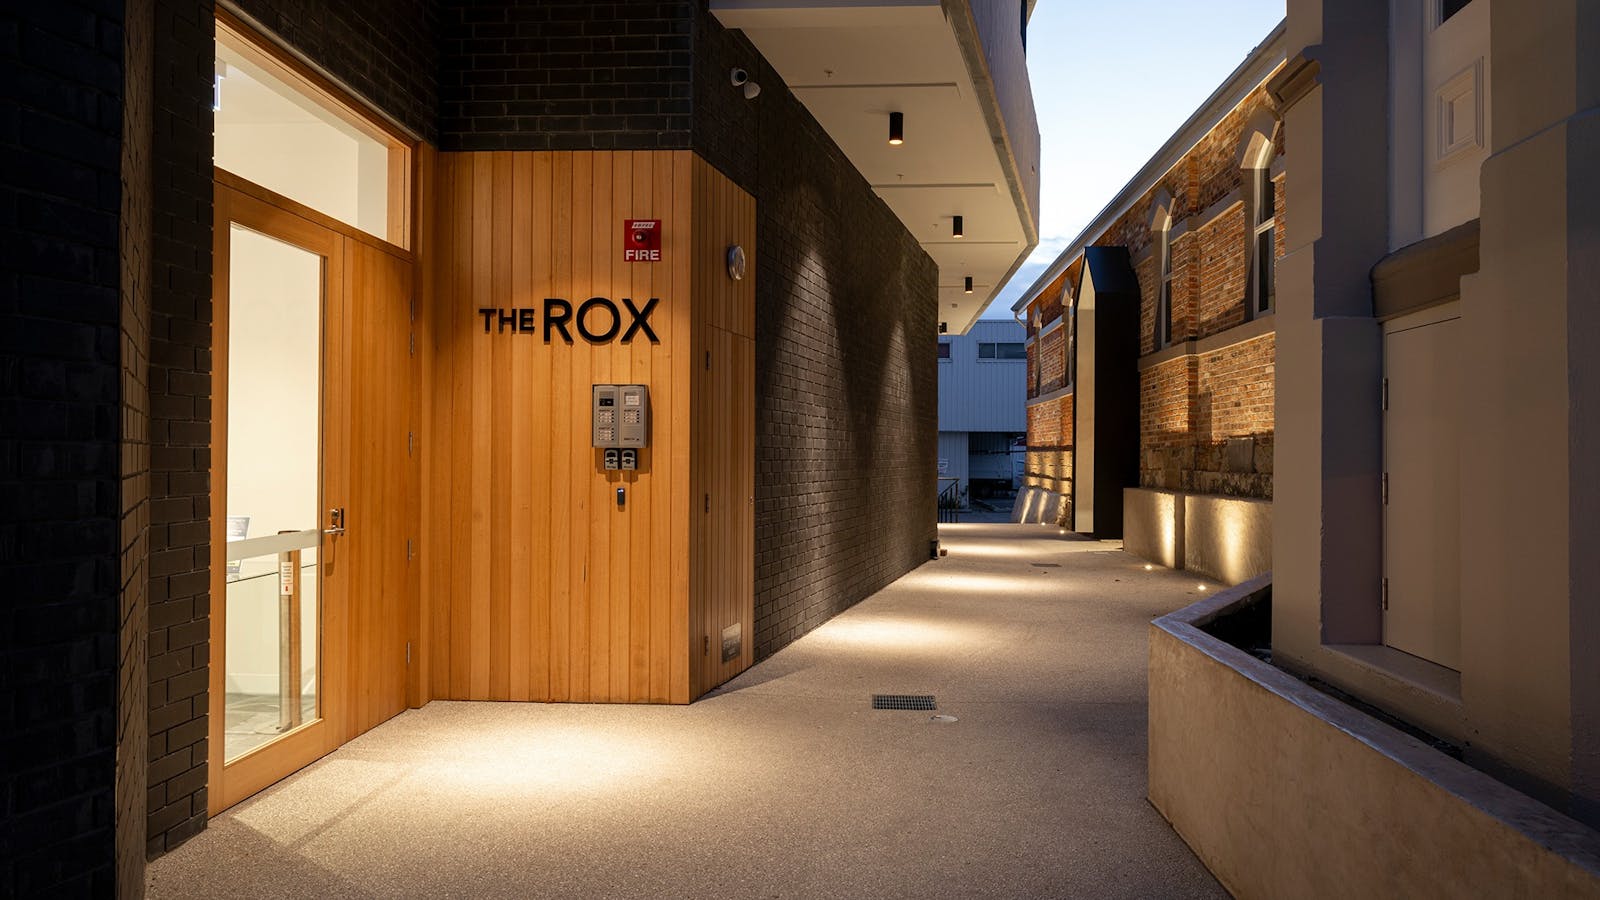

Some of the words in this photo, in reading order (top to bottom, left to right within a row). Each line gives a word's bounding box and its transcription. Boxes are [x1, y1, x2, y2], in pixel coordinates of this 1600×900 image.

[626, 249, 660, 261] FIRE
[479, 308, 535, 333] THE
[543, 297, 660, 343] ROX
